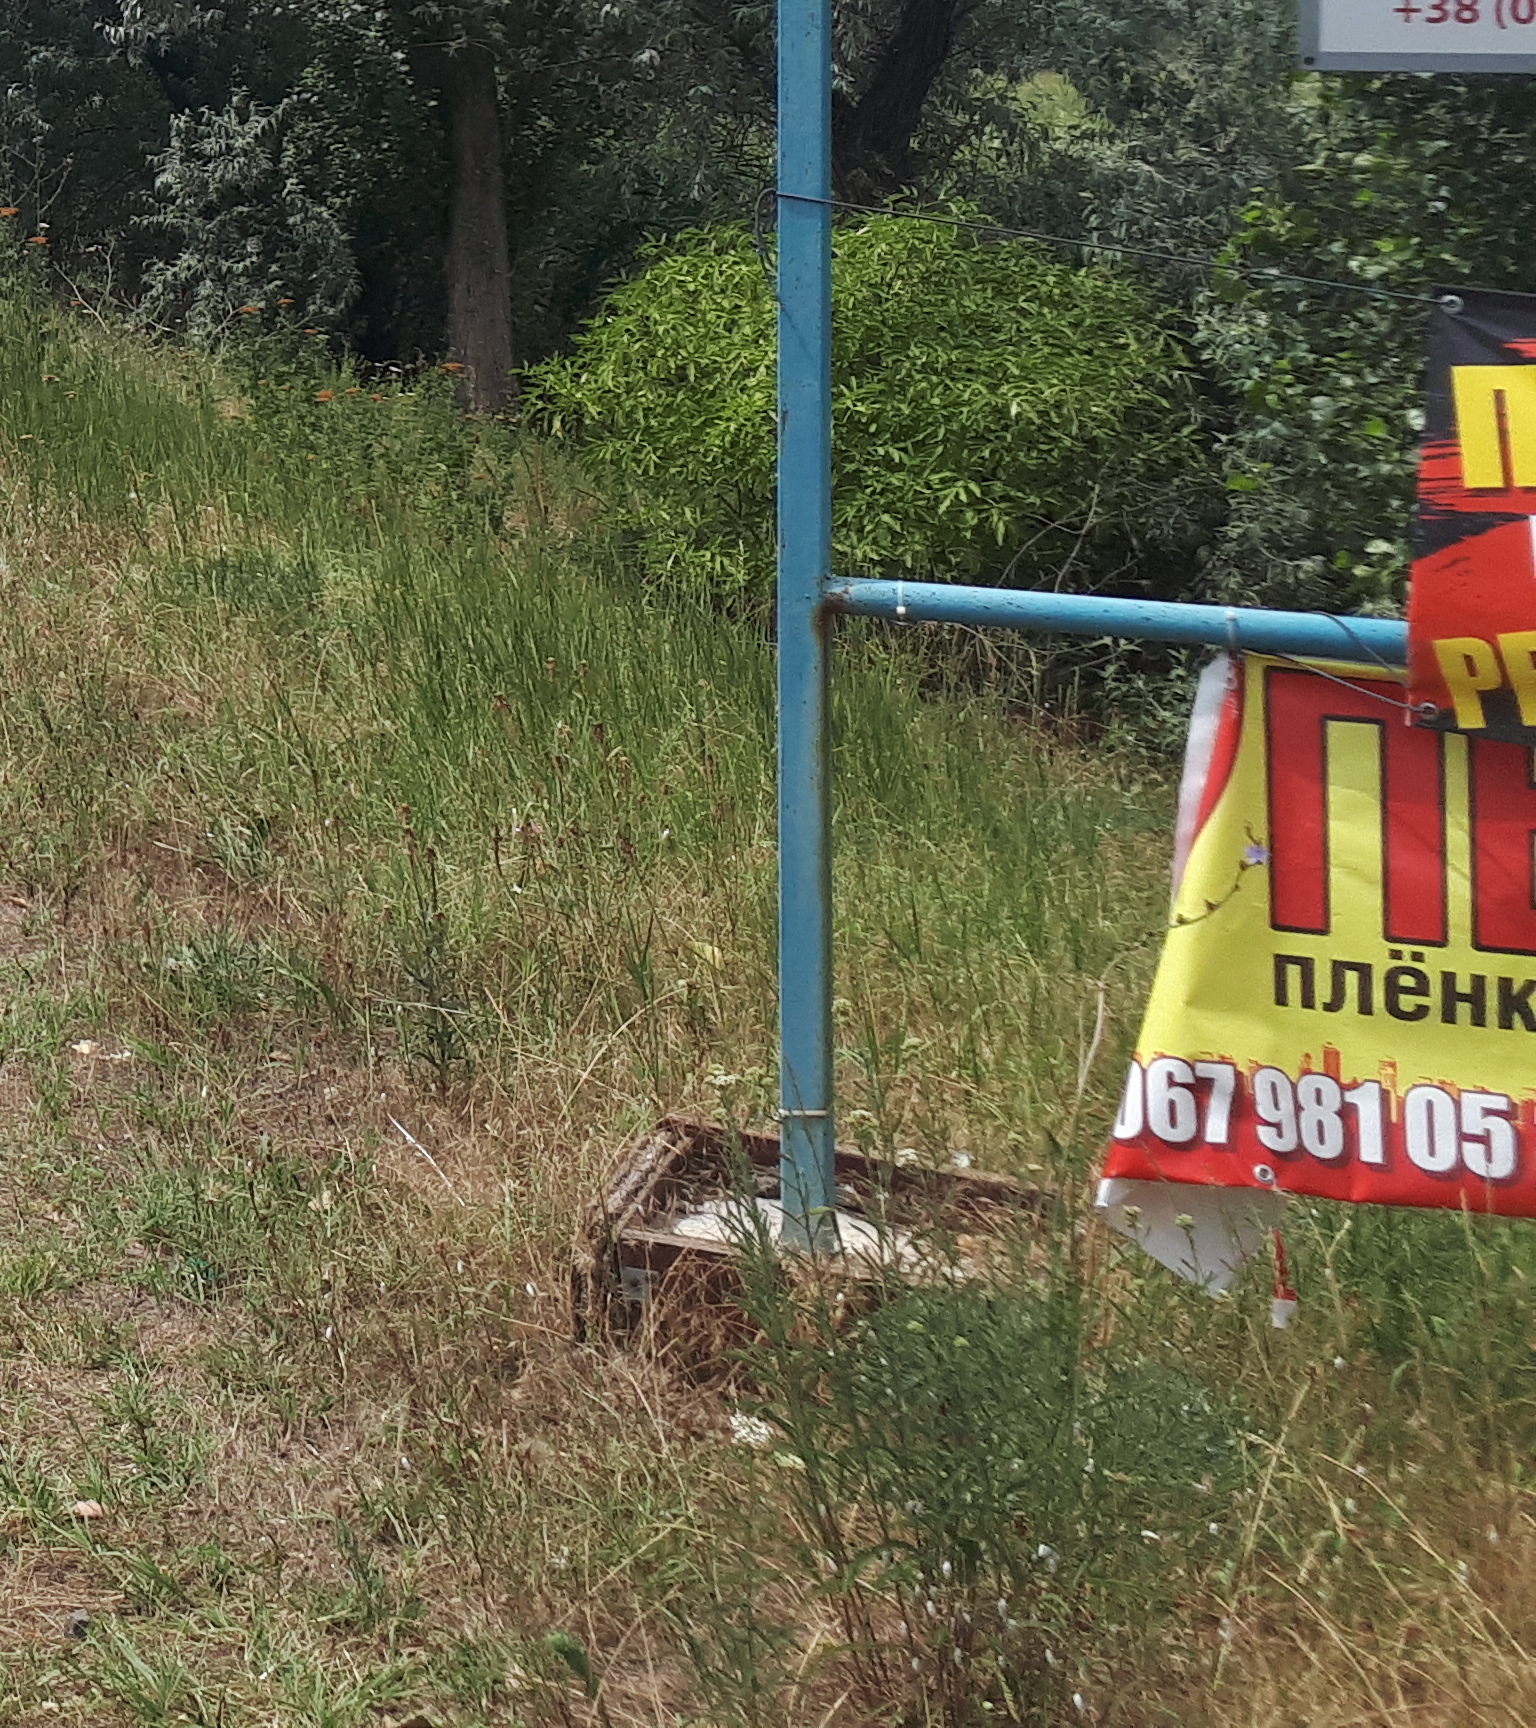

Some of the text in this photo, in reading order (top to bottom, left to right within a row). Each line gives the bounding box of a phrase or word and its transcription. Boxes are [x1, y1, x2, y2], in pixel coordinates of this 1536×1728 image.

[1273, 948, 1536, 1032] плёнк
[1252, 1065, 1389, 1166] 981
[1403, 1083, 1519, 1181] 05
